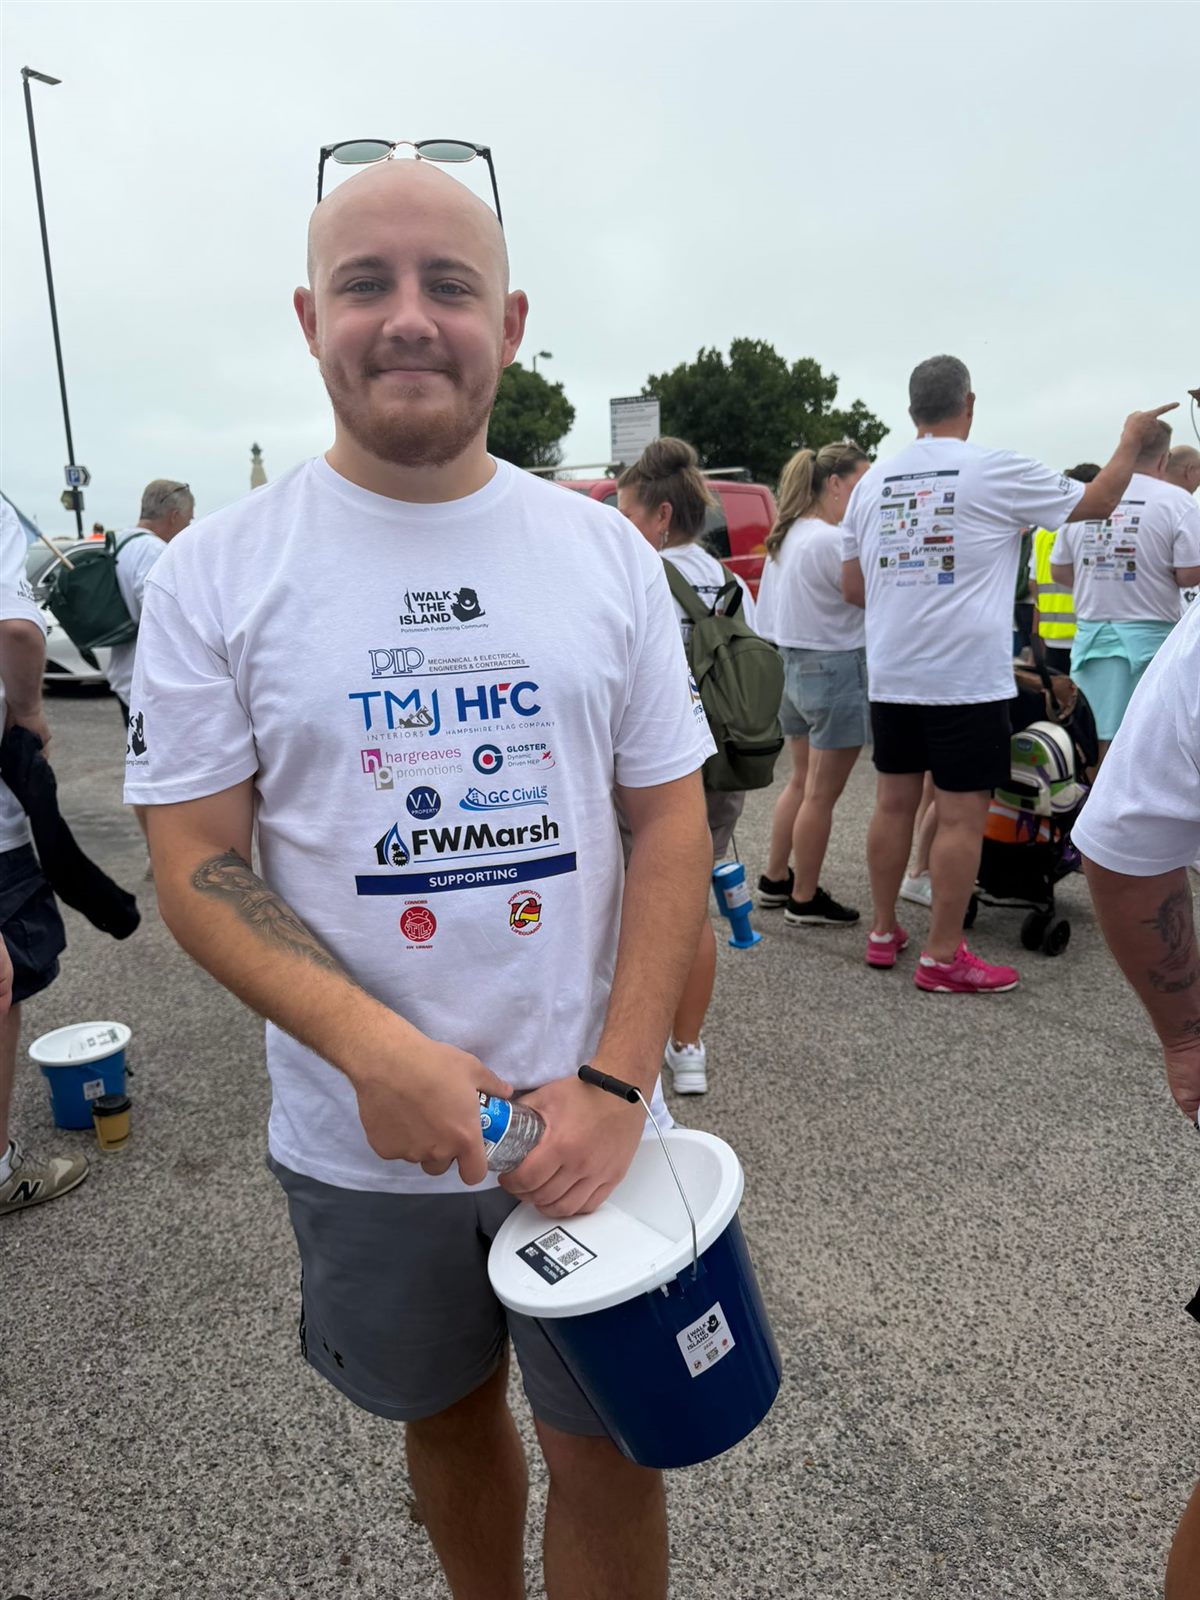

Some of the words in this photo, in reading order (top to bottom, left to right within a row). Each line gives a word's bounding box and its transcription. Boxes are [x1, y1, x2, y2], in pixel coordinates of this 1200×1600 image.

[411, 591, 452, 602] WALK
[418, 602, 446, 613] THE
[400, 613, 451, 625] ISLAND
[368, 646, 425, 676] PIP
[428, 656, 472, 665] MECHANICAL
[480, 652, 521, 661] ELECTRICAL
[429, 664, 468, 673] ENGINEERS
[475, 658, 526, 669] CONTRACTORS
[455, 681, 542, 722] HFC
[348, 688, 441, 737] TMJ
[446, 725, 492, 735] HAMPSHIRE
[496, 722, 517, 731] FLAG
[519, 720, 556, 729] COMPANY
[366, 730, 425, 741] INTERIORS
[506, 743, 547, 753] GLOSTER
[385, 747, 462, 765] hargreaves
[396, 763, 464, 779] promotions
[488, 791, 510, 803] GC
[512, 785, 548, 801] Civils
[411, 815, 560, 856] FWMarsh
[428, 868, 518, 888] SUPPORTING
[507, 889, 542, 905] PORTSMOUTH
[690, 1322, 707, 1337] WALK
[694, 1330, 706, 1340] THE
[687, 1333, 709, 1350] ISLAND
